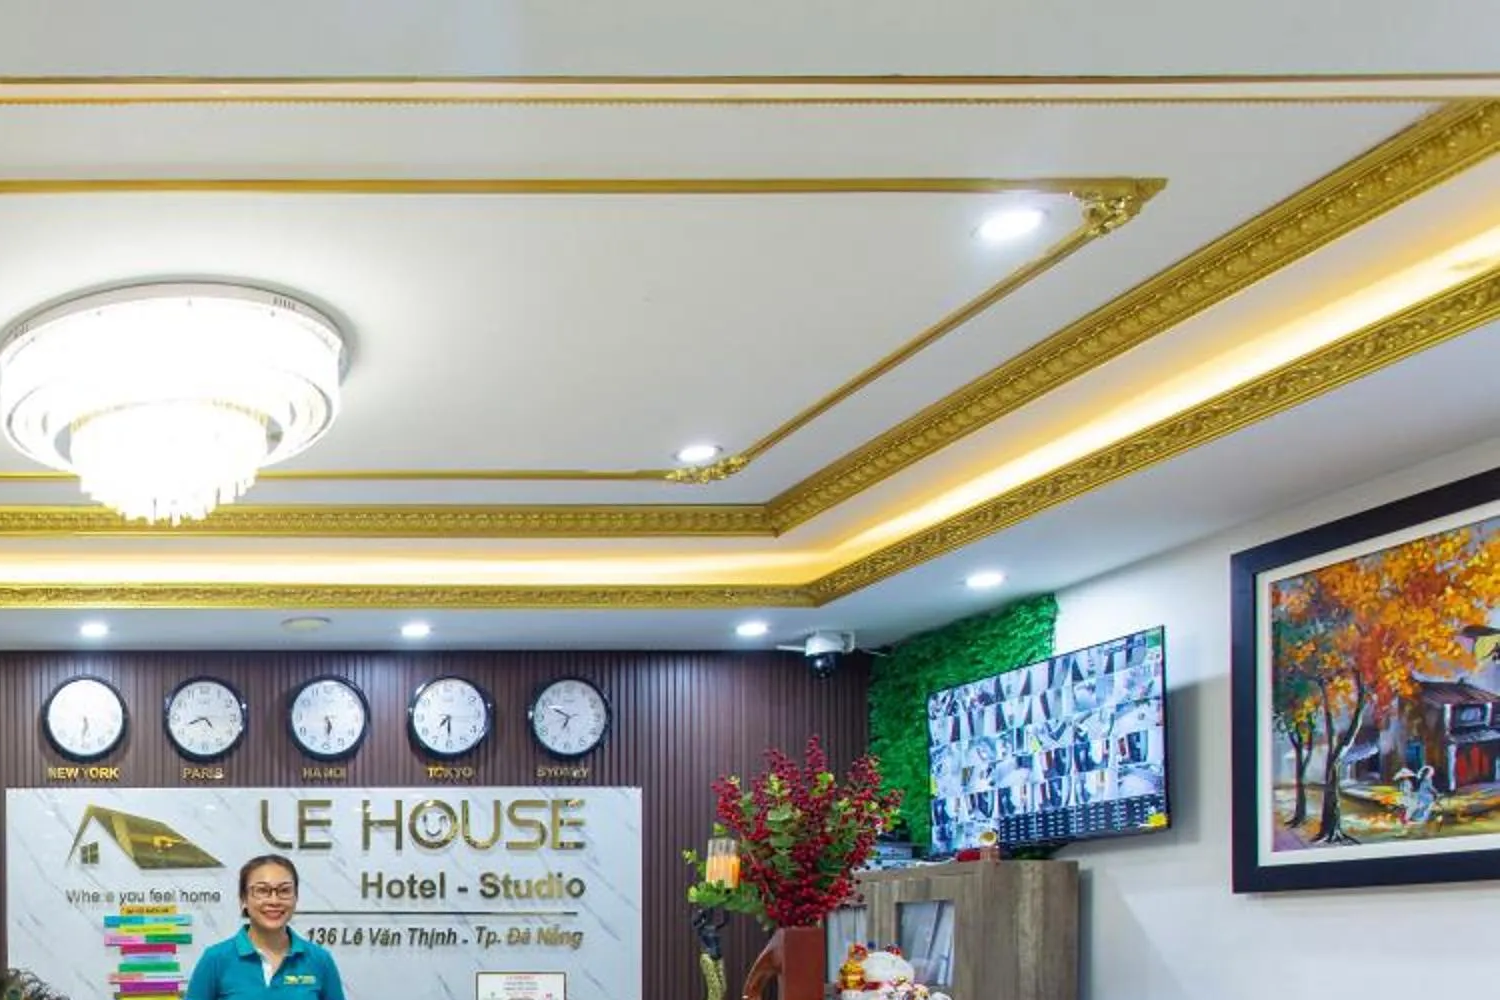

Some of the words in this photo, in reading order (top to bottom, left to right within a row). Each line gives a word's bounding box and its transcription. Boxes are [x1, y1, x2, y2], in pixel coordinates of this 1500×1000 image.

[47, 766, 79, 780] NEW
[80, 766, 119, 780] YORK
[183, 766, 225, 780] PARIS
[427, 766, 474, 779] TOKYO
[260, 799, 333, 850] LE
[361, 799, 586, 850] HOUSE
[361, 871, 446, 899] Hotel
[479, 871, 586, 899] Studio
[66, 888, 114, 903] Whee
[119, 891, 145, 906] you
[179, 888, 221, 903] home
[307, 927, 337, 945] 136
[341, 927, 364, 945] Lê
